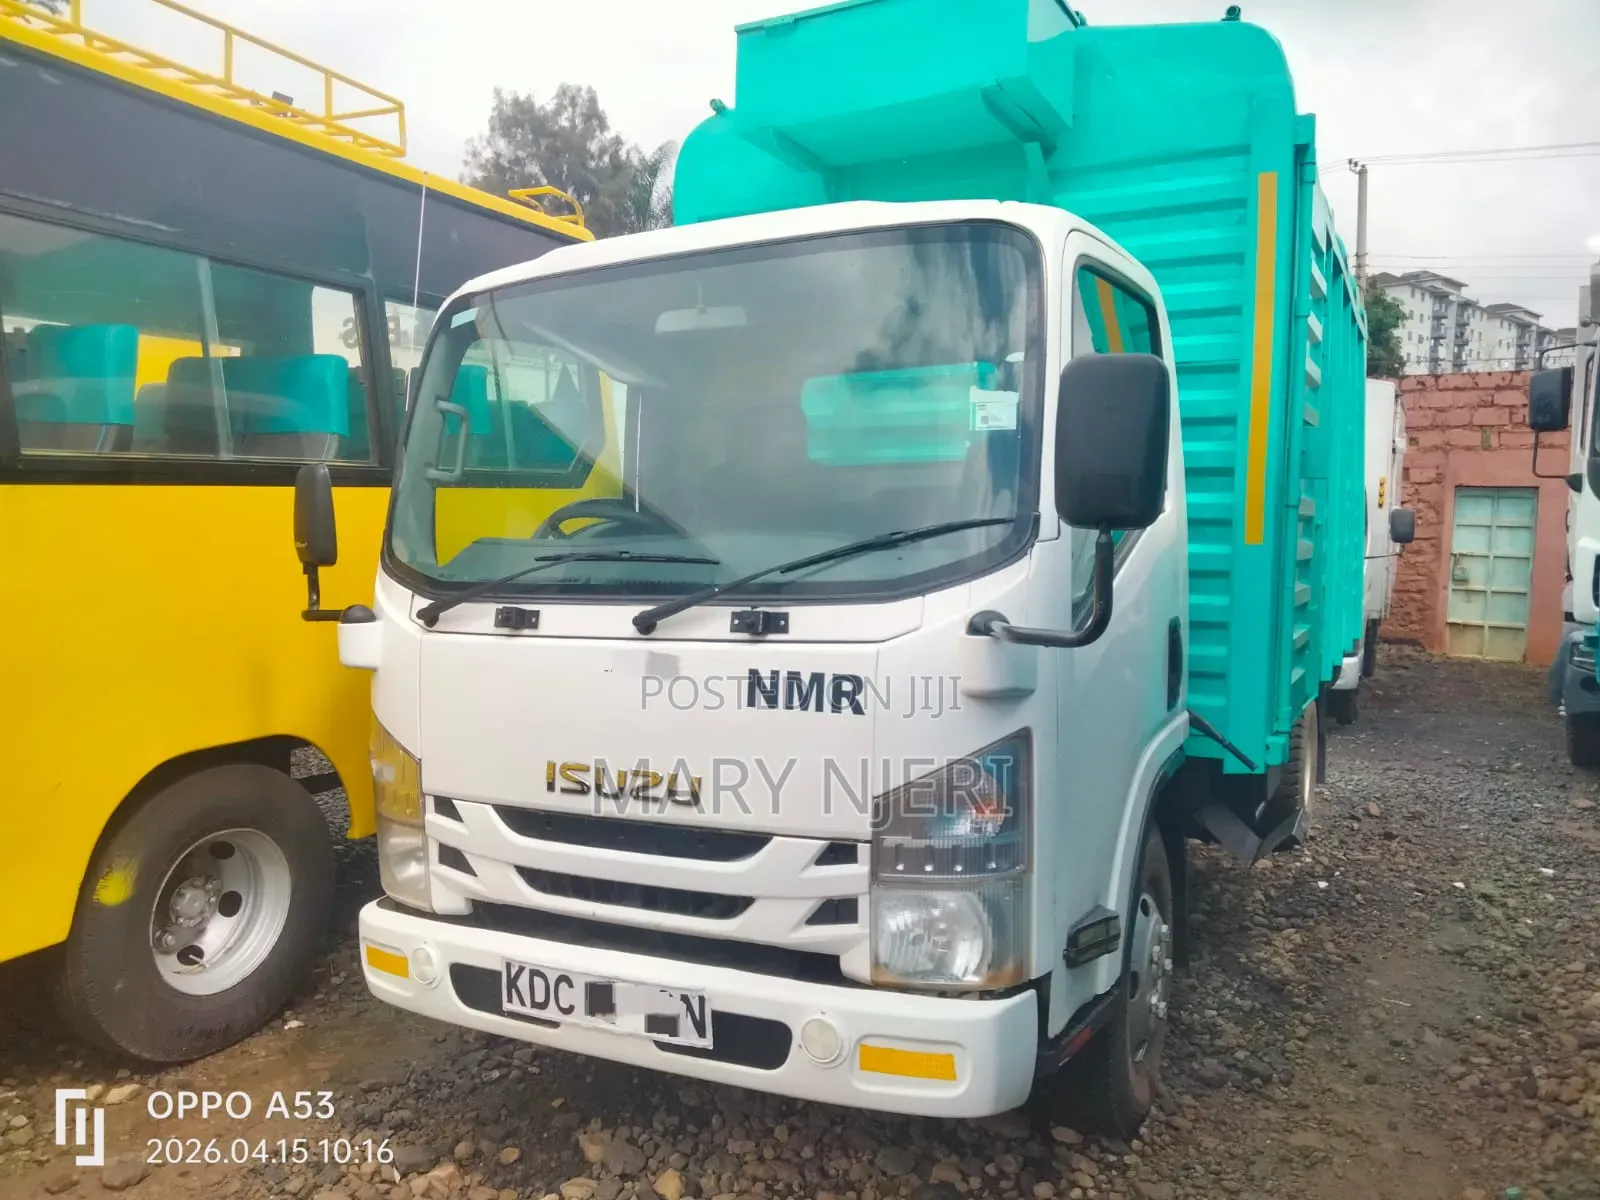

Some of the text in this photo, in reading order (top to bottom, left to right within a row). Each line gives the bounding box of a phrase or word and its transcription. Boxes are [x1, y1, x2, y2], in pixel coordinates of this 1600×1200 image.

[746, 668, 866, 716] NMR
[546, 759, 703, 808] ISUZU
[505, 961, 575, 1015] KDC
